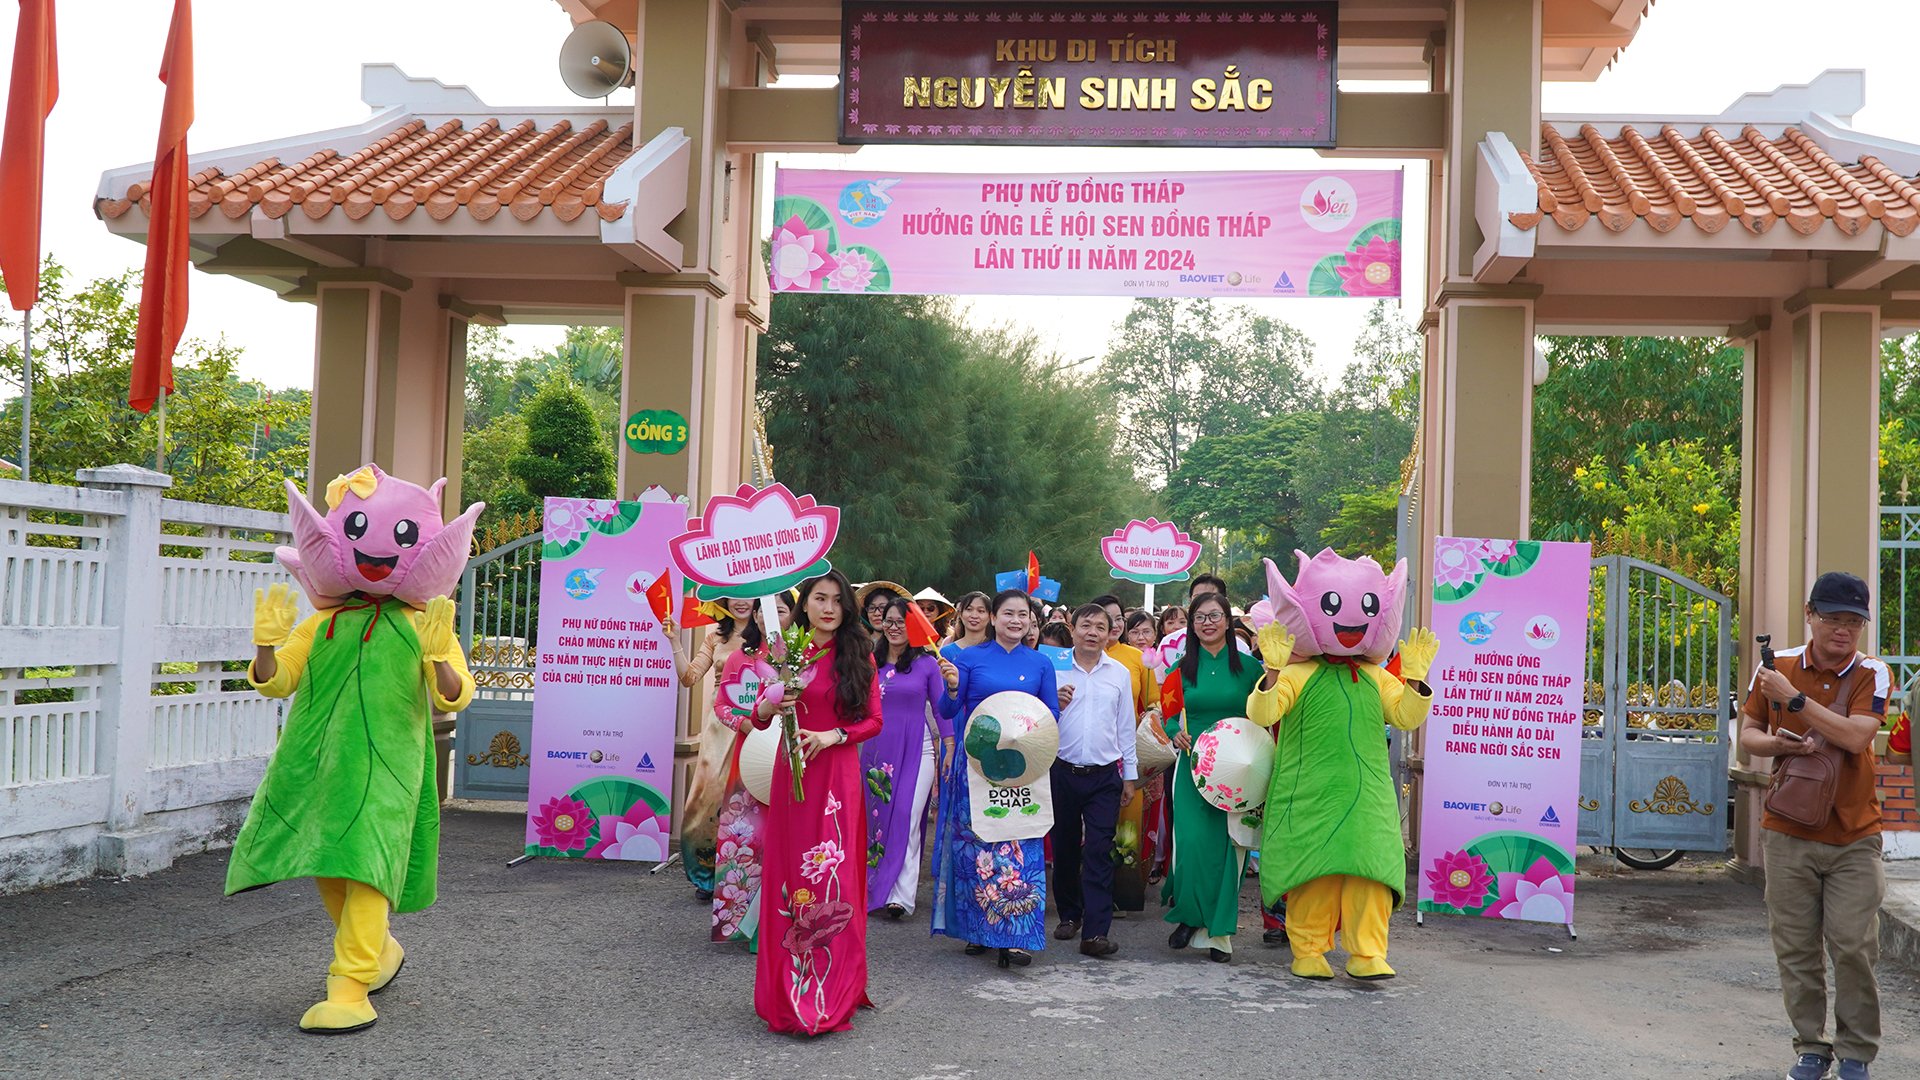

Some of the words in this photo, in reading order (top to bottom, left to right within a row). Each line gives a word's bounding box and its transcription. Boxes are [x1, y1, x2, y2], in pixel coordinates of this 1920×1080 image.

[996, 39, 1056, 62] KHU
[1067, 39, 1096, 62] DI
[1107, 33, 1176, 62] TÍCH
[903, 65, 1066, 108] NGUYỄN
[1079, 77, 1177, 111] SINH
[1190, 65, 1273, 111] SẮC
[981, 183, 1024, 207] PHỤ
[1030, 179, 1063, 203] NỮ
[1066, 176, 1124, 203] ĐỒNG
[1131, 179, 1185, 203] THÁP
[902, 207, 973, 236] HƯỞNG
[980, 210, 1023, 236] ỨNG
[1030, 207, 1053, 236] LỄ
[1061, 210, 1095, 241] HỘI
[1103, 215, 1144, 237] SEN
[1151, 208, 1210, 237] ĐỒNG
[1217, 211, 1271, 237] THÁP
[974, 240, 1014, 269] LẦN
[1021, 244, 1063, 270] THỨ
[1068, 249, 1081, 270] II
[1088, 244, 1137, 270] NĂM
[1144, 249, 1196, 271] 2024
[1179, 274, 1225, 283] BAOVIET
[1244, 275, 1261, 284] Life
[627, 417, 673, 442] CỔNG
[677, 425, 687, 442] 3
[696, 543, 721, 561] LÃNH
[722, 539, 741, 558] ĐẠO
[742, 532, 774, 552] TRUNG
[774, 527, 801, 546] ƯƠNG
[801, 522, 819, 543] HỘI
[726, 556, 753, 577] LÃNH
[753, 554, 773, 574] ĐẠO
[773, 548, 796, 568] TỈNH
[562, 618, 581, 632] PHỤ
[584, 618, 599, 630] NỮ
[600, 617, 627, 631] ĐỒNG
[629, 620, 653, 632] THÁP
[558, 634, 584, 648] CHÀO
[587, 636, 615, 649] MỪNG
[618, 636, 631, 650] KỶ
[633, 638, 658, 653] NIỆM
[542, 654, 554, 664] 55
[557, 653, 579, 665] NĂM
[582, 655, 606, 668] THỰC
[608, 655, 631, 669] HIỆN
[633, 658, 643, 668] DI
[646, 656, 672, 670] CHÚC
[1474, 651, 1513, 667] HƯỞNG
[1517, 653, 1541, 668] ỨNG
[542, 669, 561, 683] CỦA
[564, 670, 583, 684] CHỦ
[586, 673, 607, 687] TỊCH
[625, 675, 641, 686] CHÍ
[644, 676, 670, 687] MINH
[1442, 666, 1455, 681] LỄ
[1458, 668, 1478, 685] HỘI
[1481, 671, 1504, 684] SEN
[1507, 670, 1539, 687] ĐỒNG
[1542, 674, 1572, 688] THÁP
[738, 692, 756, 704] ĐỒN
[1444, 684, 1466, 700] LẦN
[1470, 688, 1493, 701] THỨ
[1494, 690, 1502, 702] II
[1505, 688, 1532, 703] NĂM
[1535, 693, 1564, 706] 2024
[1432, 705, 1463, 717] 5.500
[1466, 706, 1490, 721] PHỤ
[1493, 707, 1511, 720] NỮ
[1512, 706, 1544, 722] ĐỒNG
[1547, 710, 1577, 725] THÁP
[1482, 723, 1513, 738] HÀNH
[1516, 725, 1532, 740] ÁO
[1535, 727, 1555, 741] DÀI
[547, 750, 588, 760] BAOVIET
[605, 753, 620, 762] Life
[1446, 741, 1477, 756] RẠNG
[1480, 742, 1508, 756] NGỜI
[1511, 741, 1534, 758] SẮC
[1537, 747, 1561, 760] SEN
[1443, 800, 1487, 811] BAOVIET
[1505, 805, 1522, 815] Life
